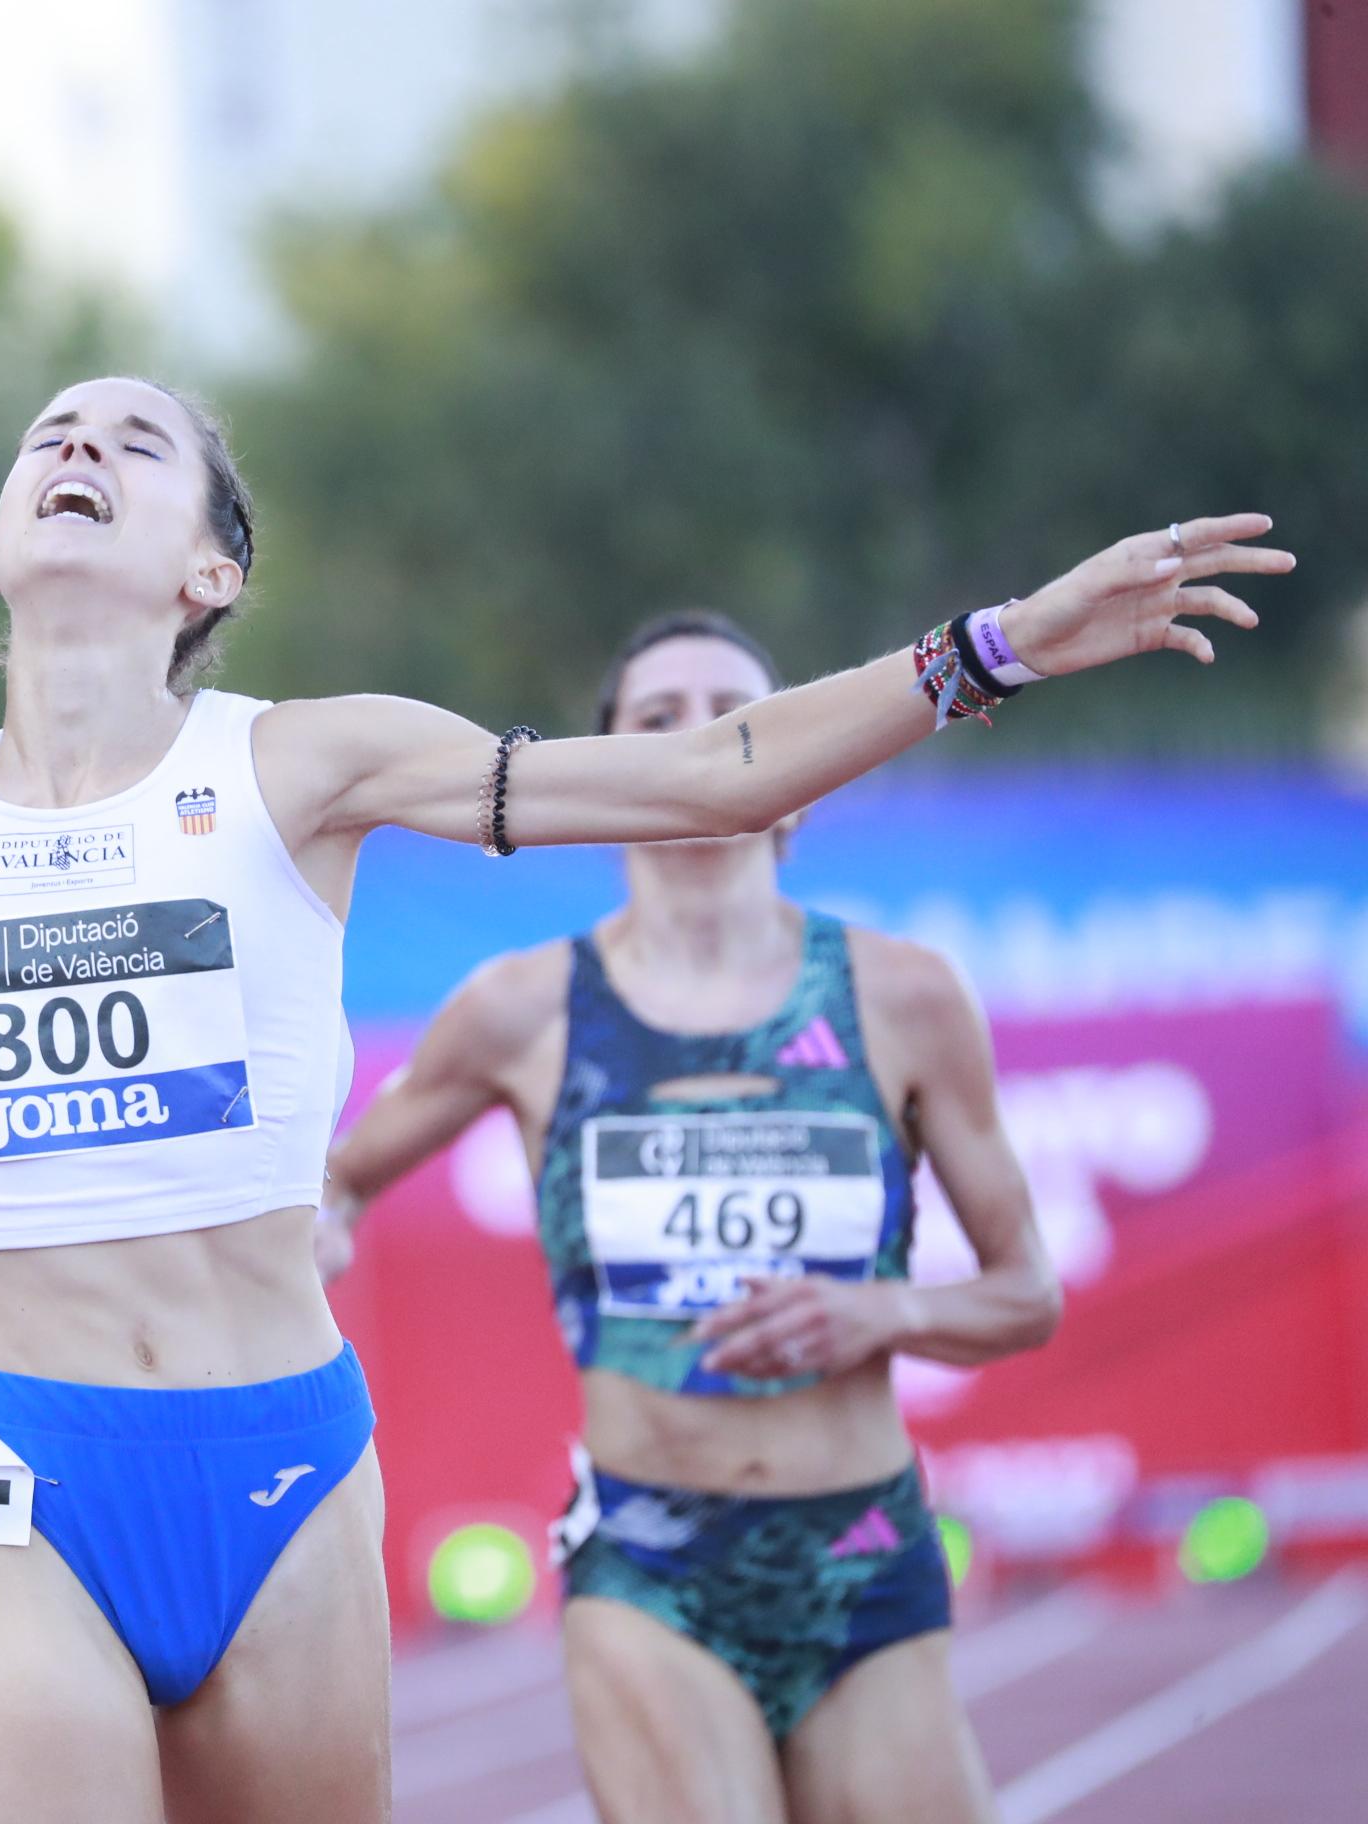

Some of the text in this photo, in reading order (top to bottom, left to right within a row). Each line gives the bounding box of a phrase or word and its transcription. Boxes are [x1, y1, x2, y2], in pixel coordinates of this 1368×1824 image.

[104, 832, 125, 842] DE
[19, 912, 139, 952] Diputació
[20, 947, 165, 985] de València
[663, 1190, 805, 1251] 469
